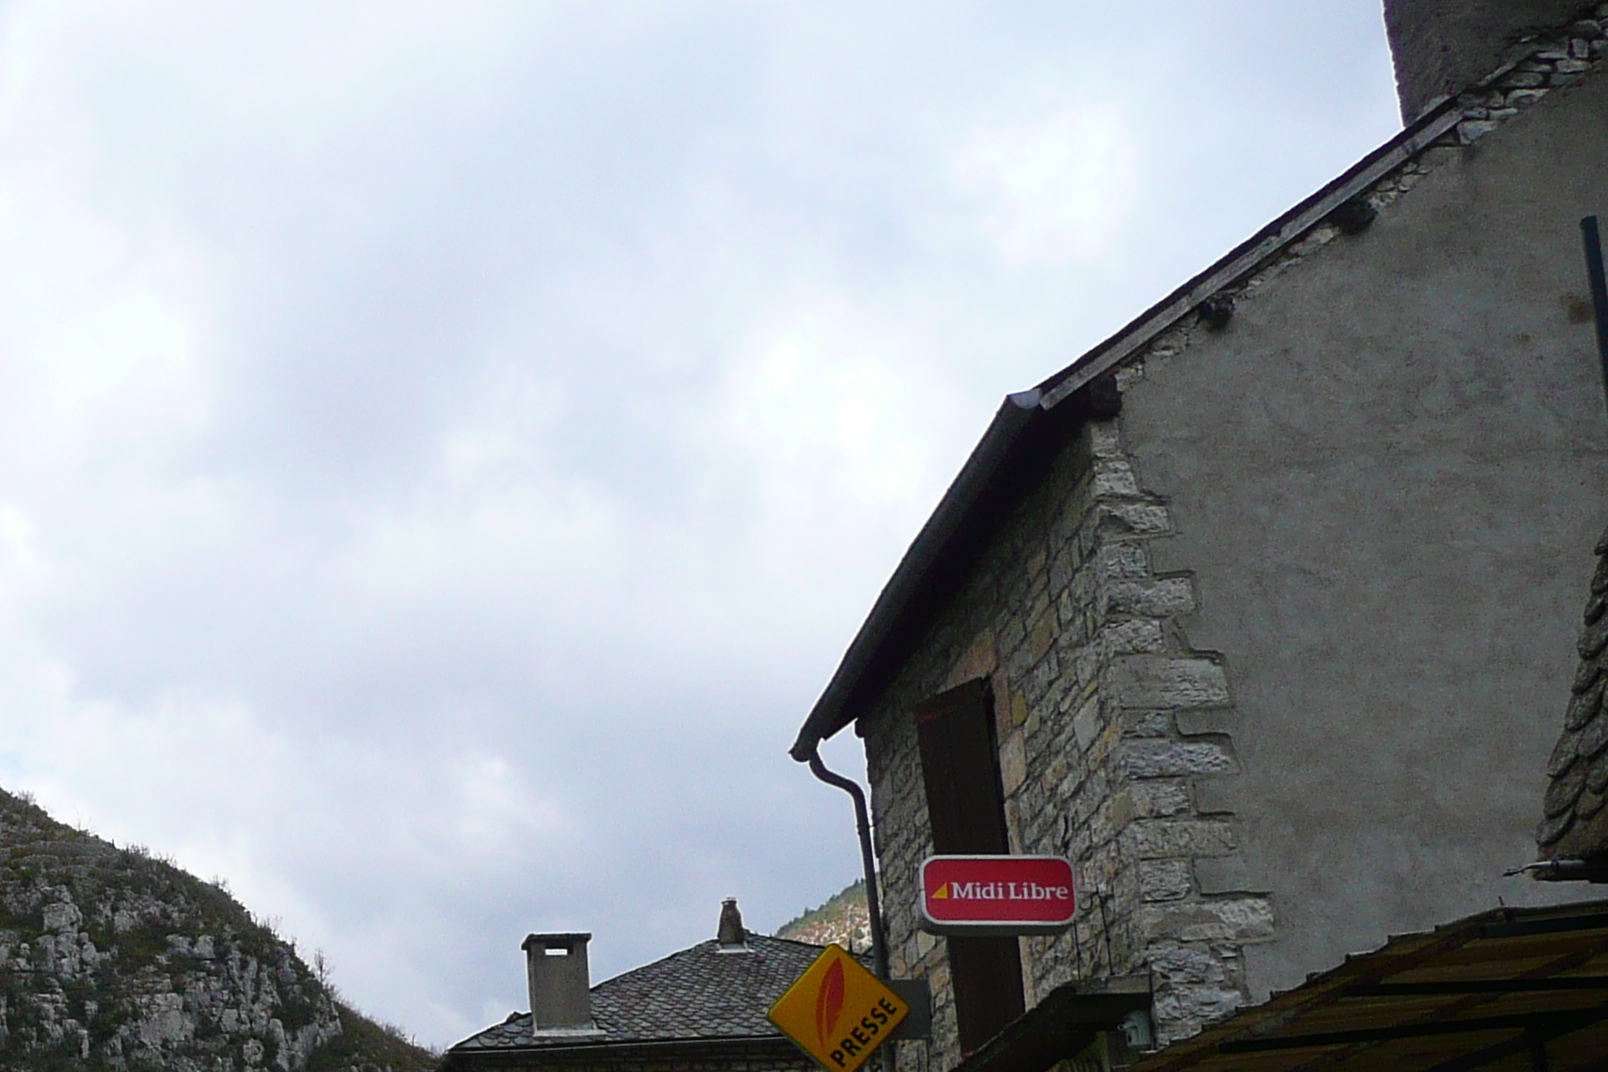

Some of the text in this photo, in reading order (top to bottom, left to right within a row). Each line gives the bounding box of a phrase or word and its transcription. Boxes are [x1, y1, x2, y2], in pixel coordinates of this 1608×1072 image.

[951, 881, 1069, 900] Midi Libre
[830, 996, 898, 1068] PRESSE
